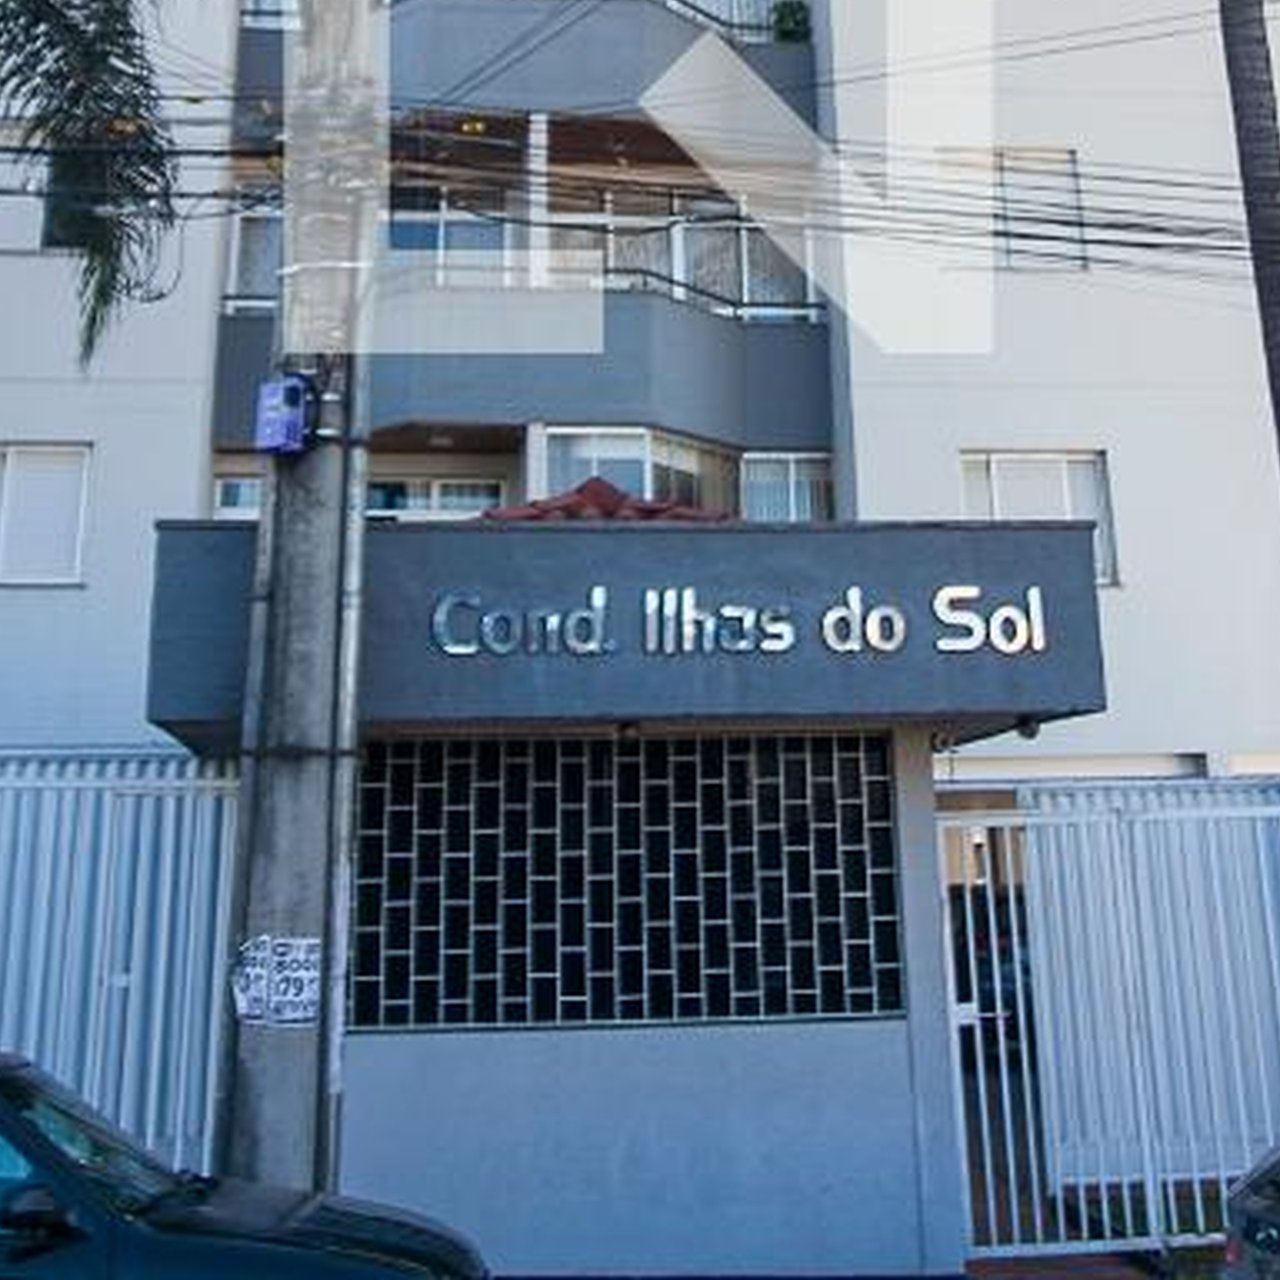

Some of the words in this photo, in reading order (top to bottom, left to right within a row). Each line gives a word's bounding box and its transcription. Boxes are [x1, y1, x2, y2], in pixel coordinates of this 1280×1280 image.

[644, 586, 795, 654] Ilhas
[822, 586, 905, 652] do
[932, 586, 1046, 653] Sol
